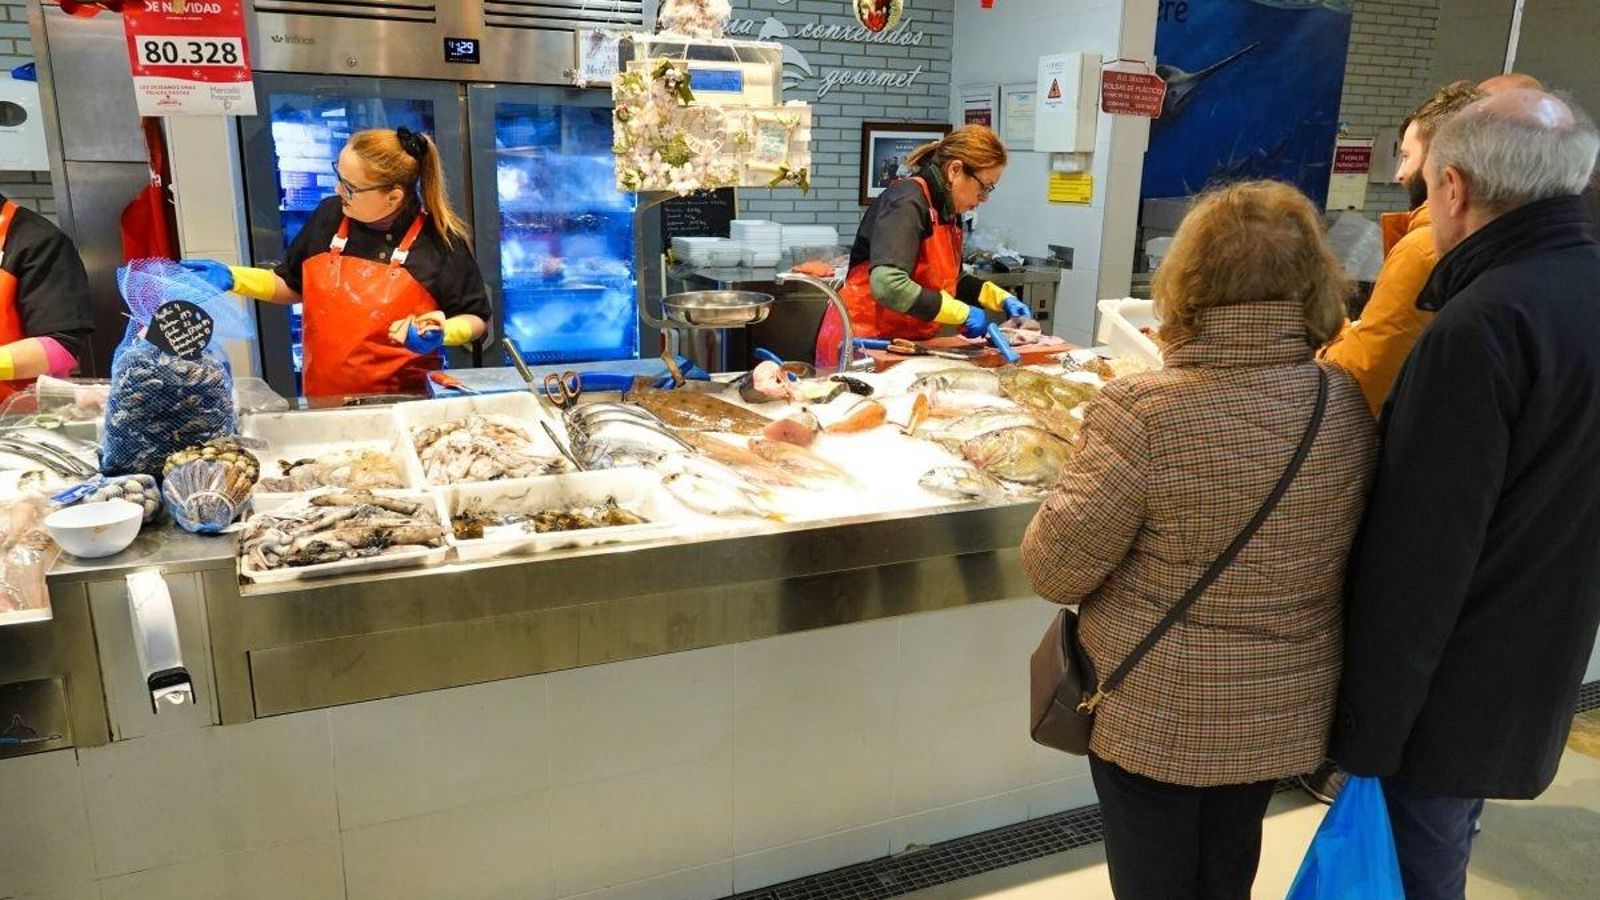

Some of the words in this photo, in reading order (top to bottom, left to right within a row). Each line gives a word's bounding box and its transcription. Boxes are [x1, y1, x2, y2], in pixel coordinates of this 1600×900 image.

[162, 1, 221, 14] NVIDAD
[144, 41, 238, 64] 80.328
[816, 65, 923, 98] gourmet
